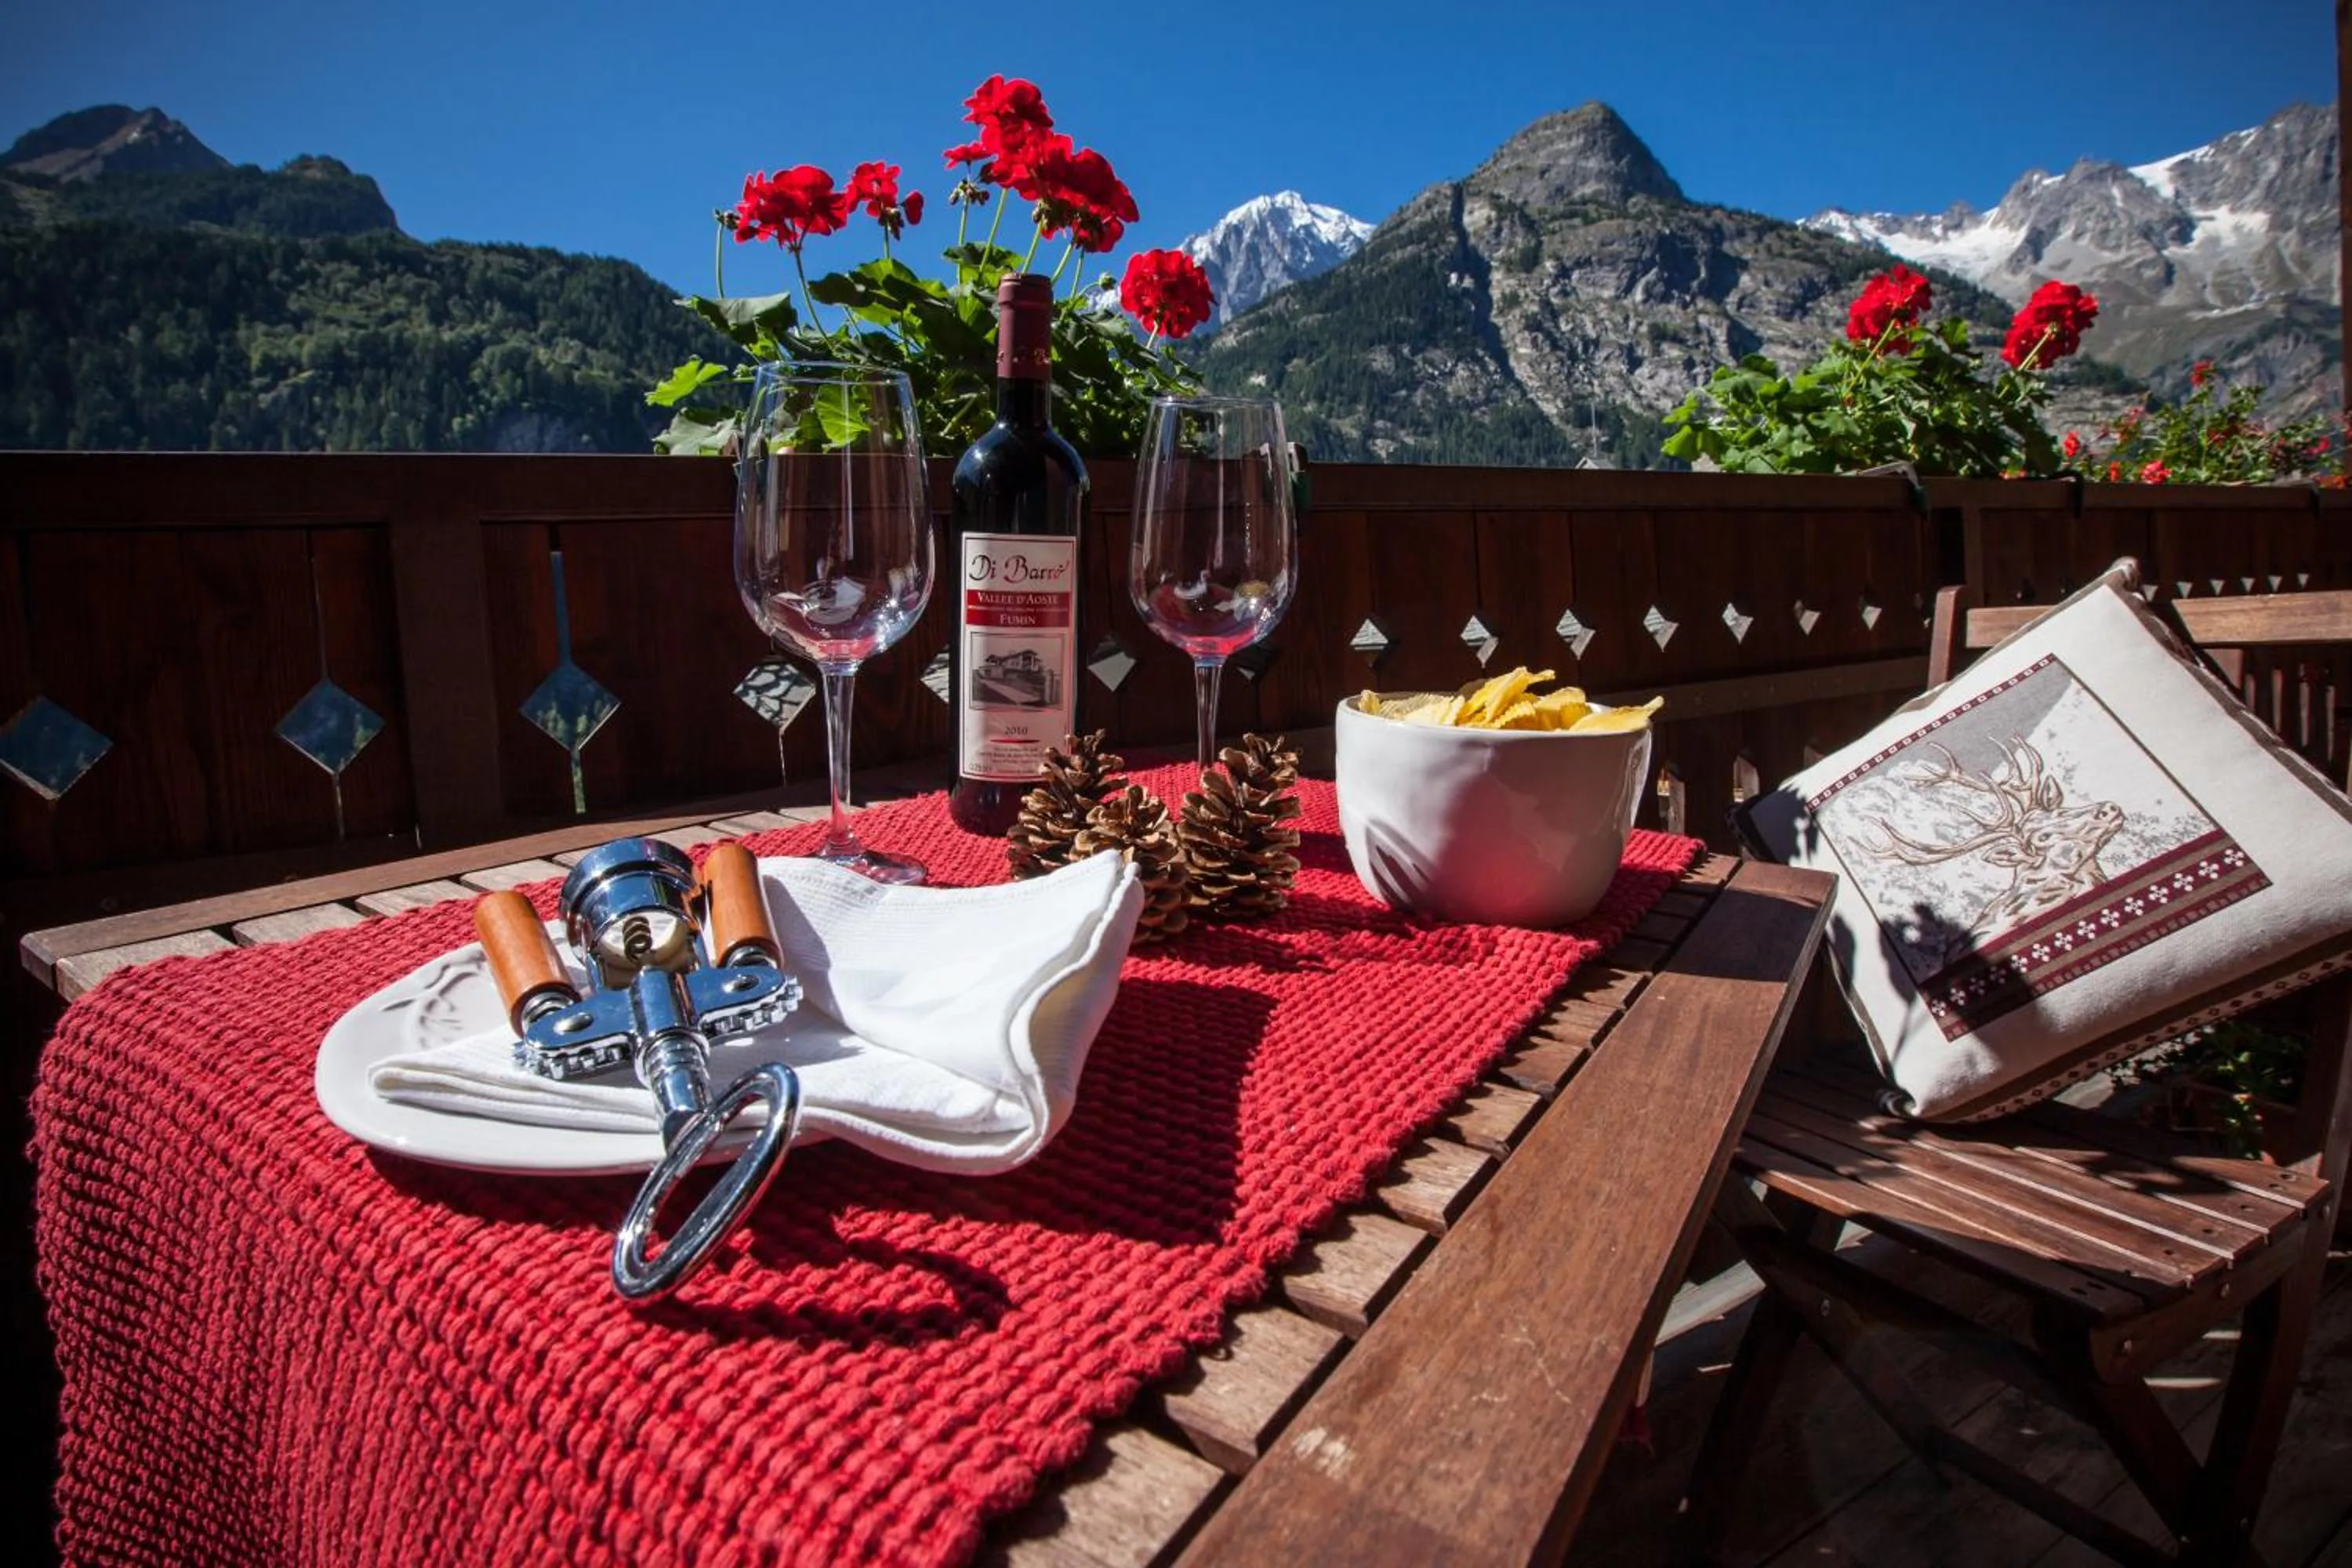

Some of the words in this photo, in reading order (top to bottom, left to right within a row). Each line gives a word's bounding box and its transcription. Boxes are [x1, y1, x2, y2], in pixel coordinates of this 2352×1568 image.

[969, 554, 996, 581] Di
[1000, 614, 1036, 625] FUMIN
[1004, 726, 1029, 735] 2010
